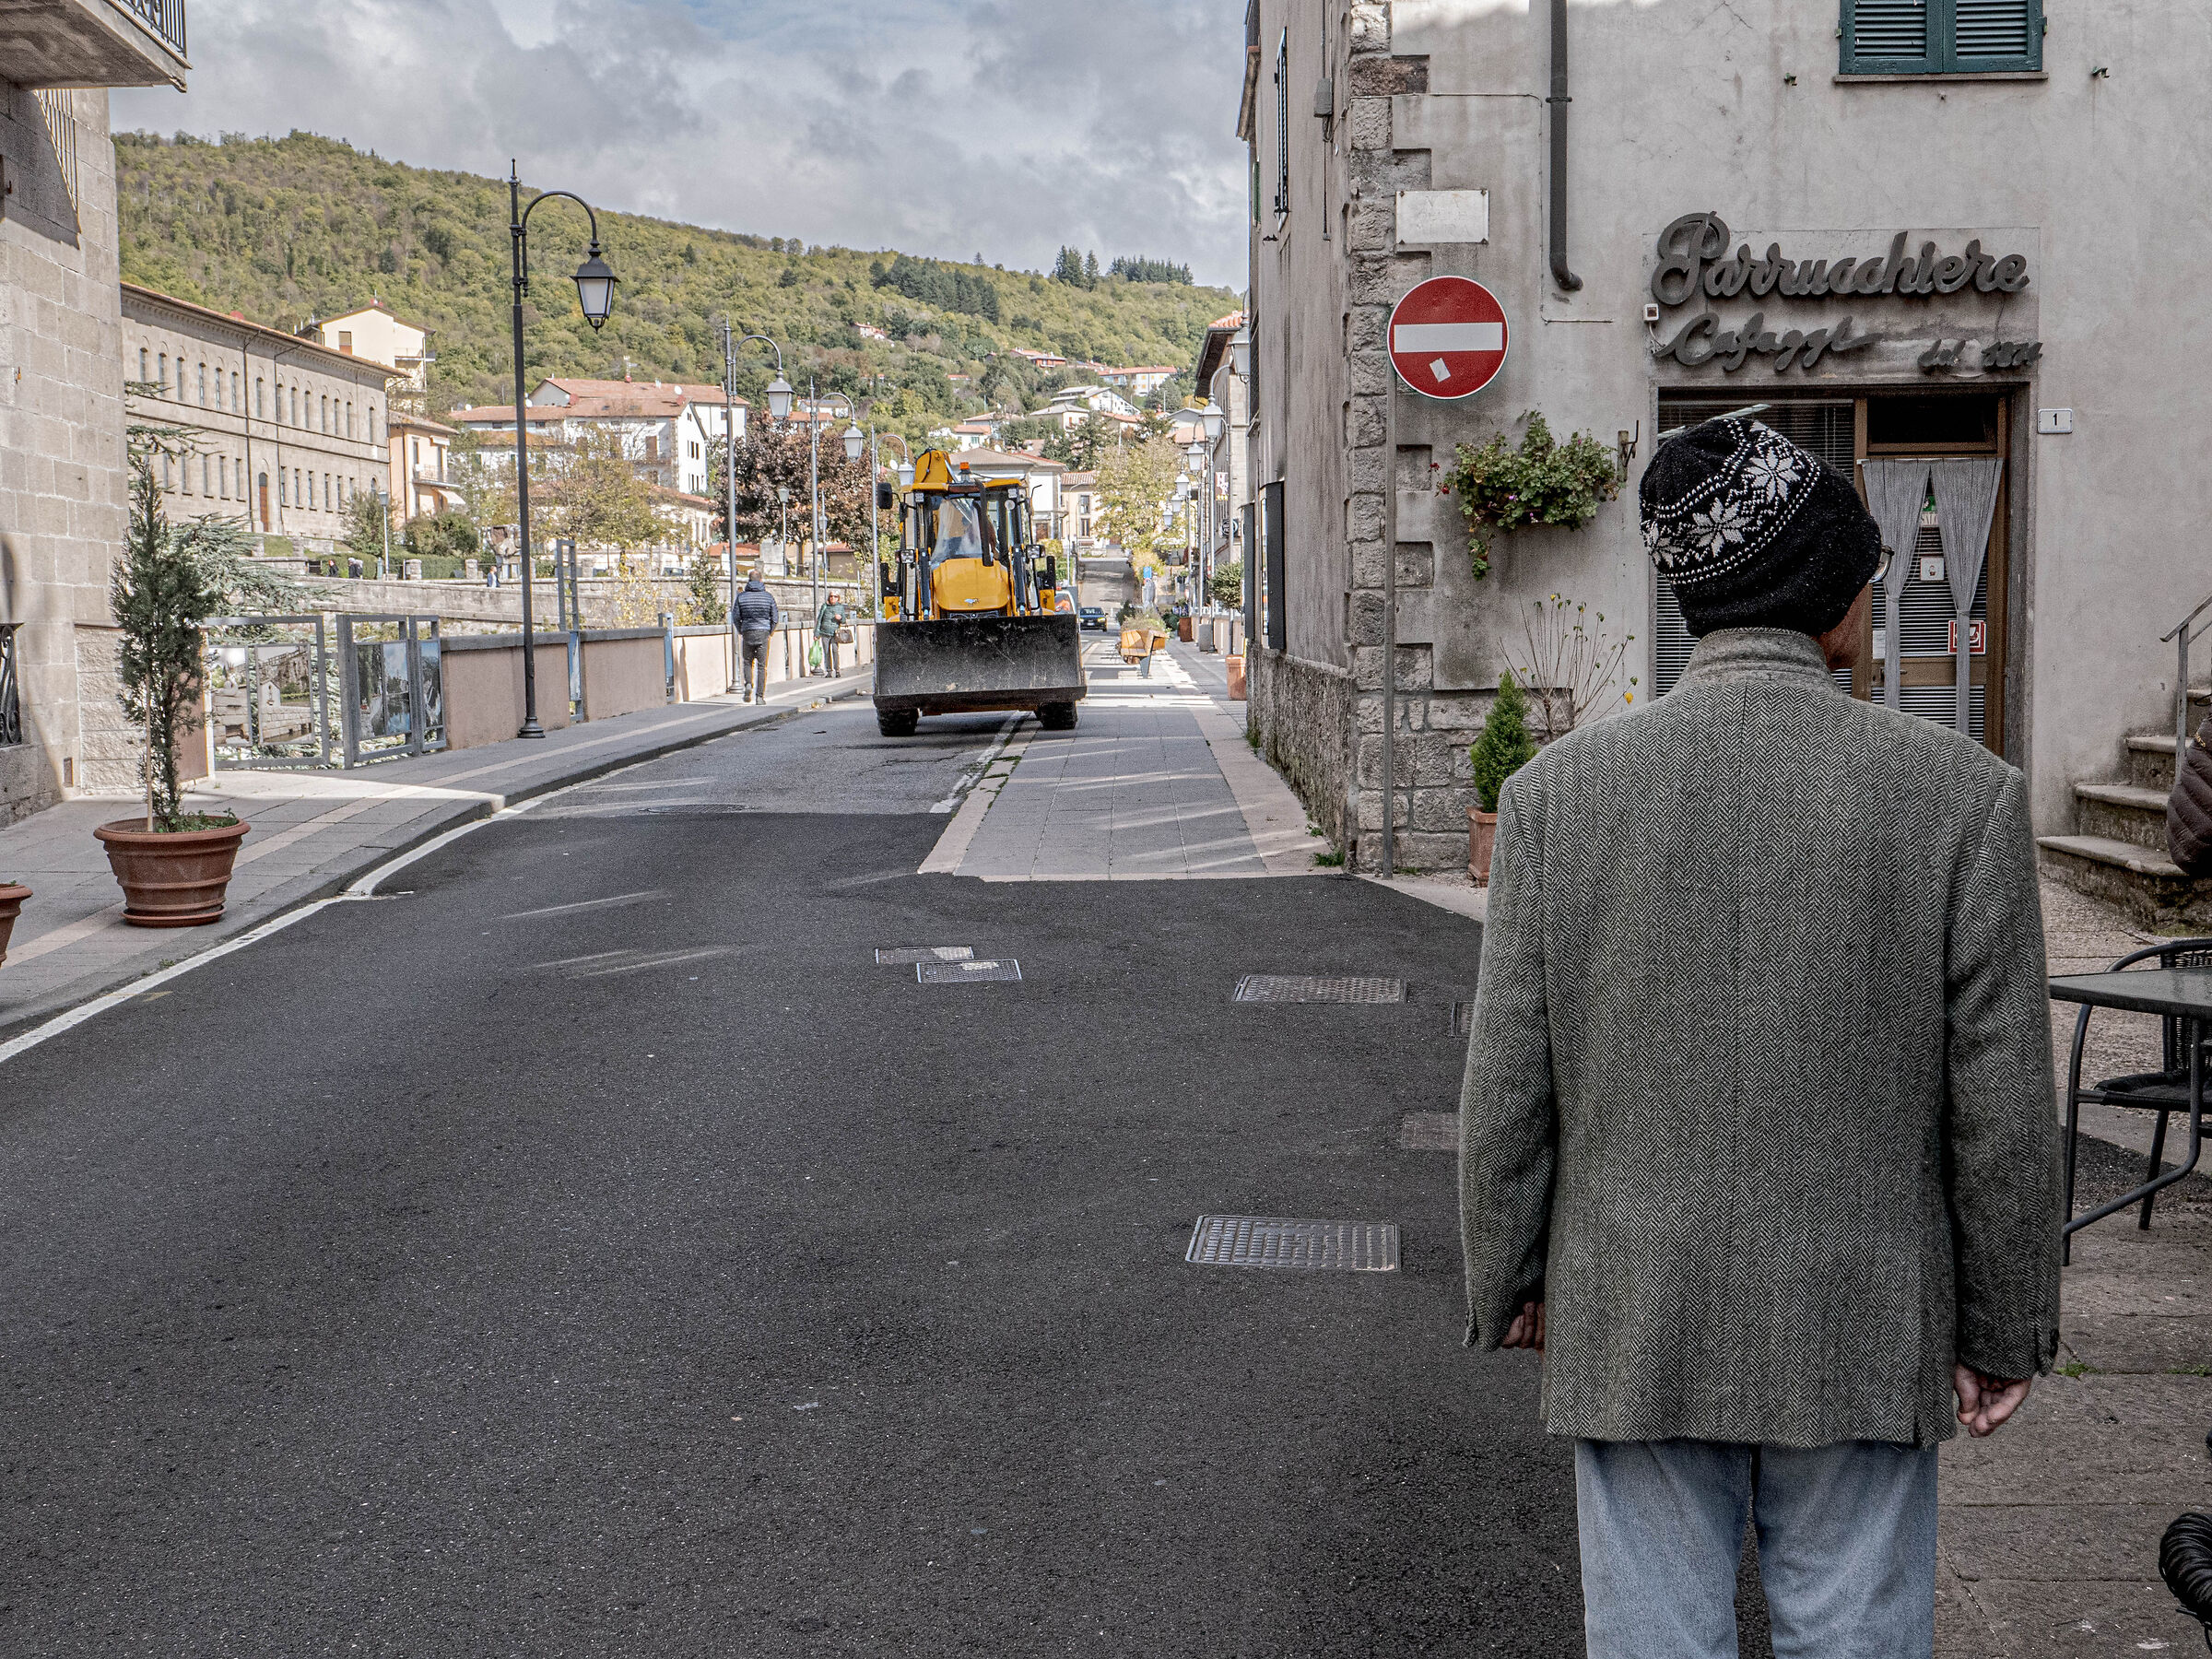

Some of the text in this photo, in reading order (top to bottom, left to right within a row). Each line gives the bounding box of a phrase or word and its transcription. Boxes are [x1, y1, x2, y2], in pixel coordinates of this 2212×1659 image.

[1651, 210, 2030, 305] Parrucchiere
[1655, 312, 1884, 371] Cafaggi
[2053, 413, 2057, 426] 1
